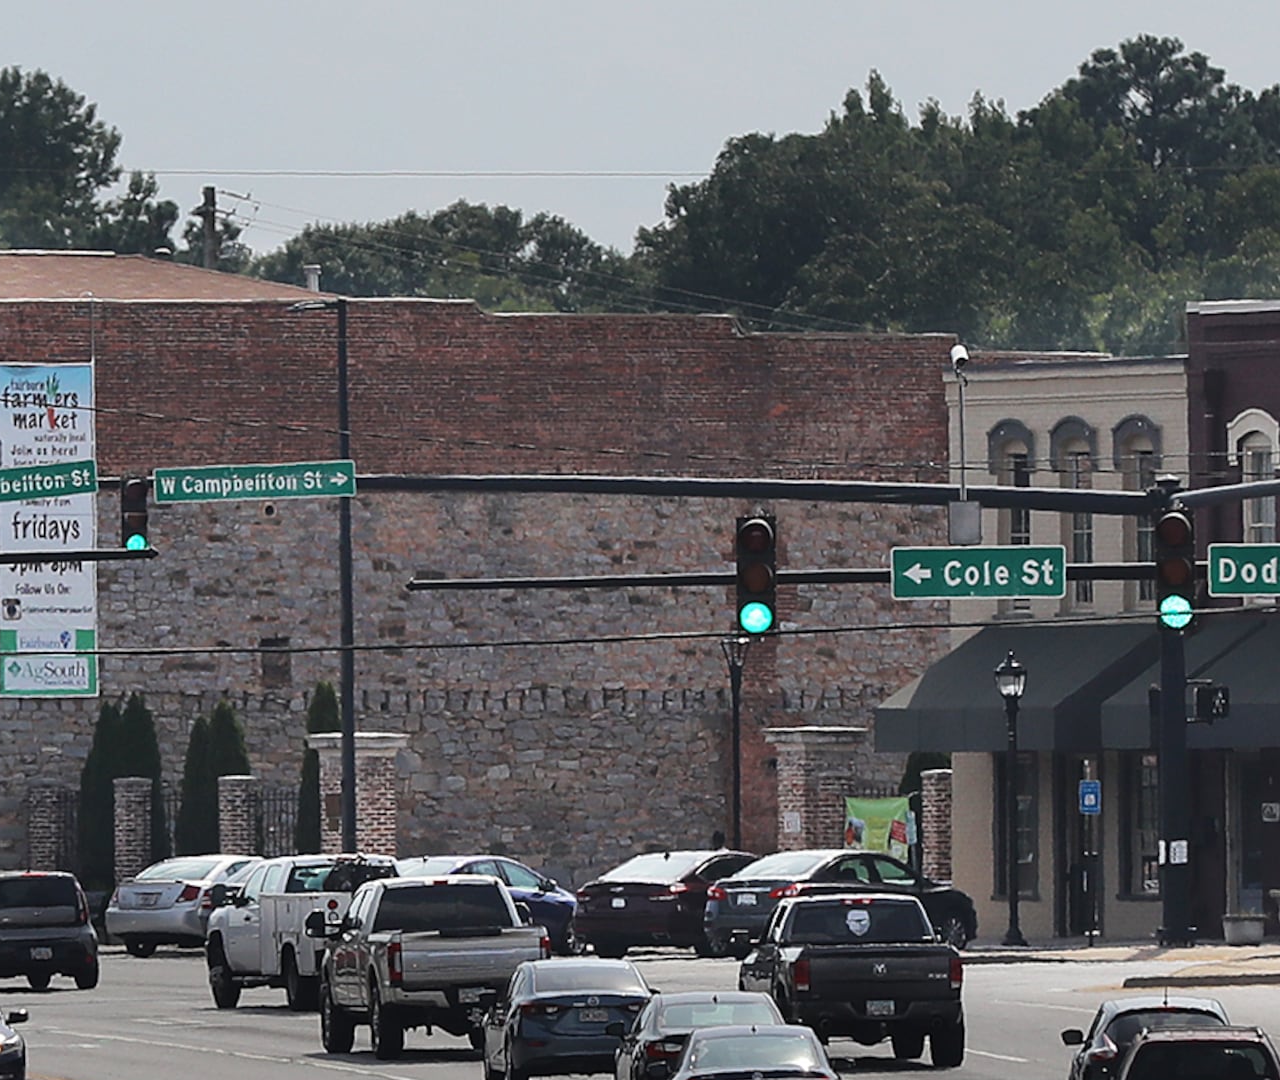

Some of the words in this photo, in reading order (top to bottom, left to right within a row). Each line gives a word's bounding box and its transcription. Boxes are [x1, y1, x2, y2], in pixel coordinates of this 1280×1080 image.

[11, 445, 33, 456] Join
[36, 446, 47, 456] us
[51, 444, 78, 456] here!
[71, 469, 91, 488] St
[161, 477, 177, 495] W
[303, 471, 324, 489] St
[12, 512, 81, 544] fridays
[943, 560, 1010, 587] Cole
[1020, 558, 1056, 586] St
[15, 583, 41, 595] Follow
[44, 583, 55, 595] Us
[22, 661, 86, 682] AgSouth
